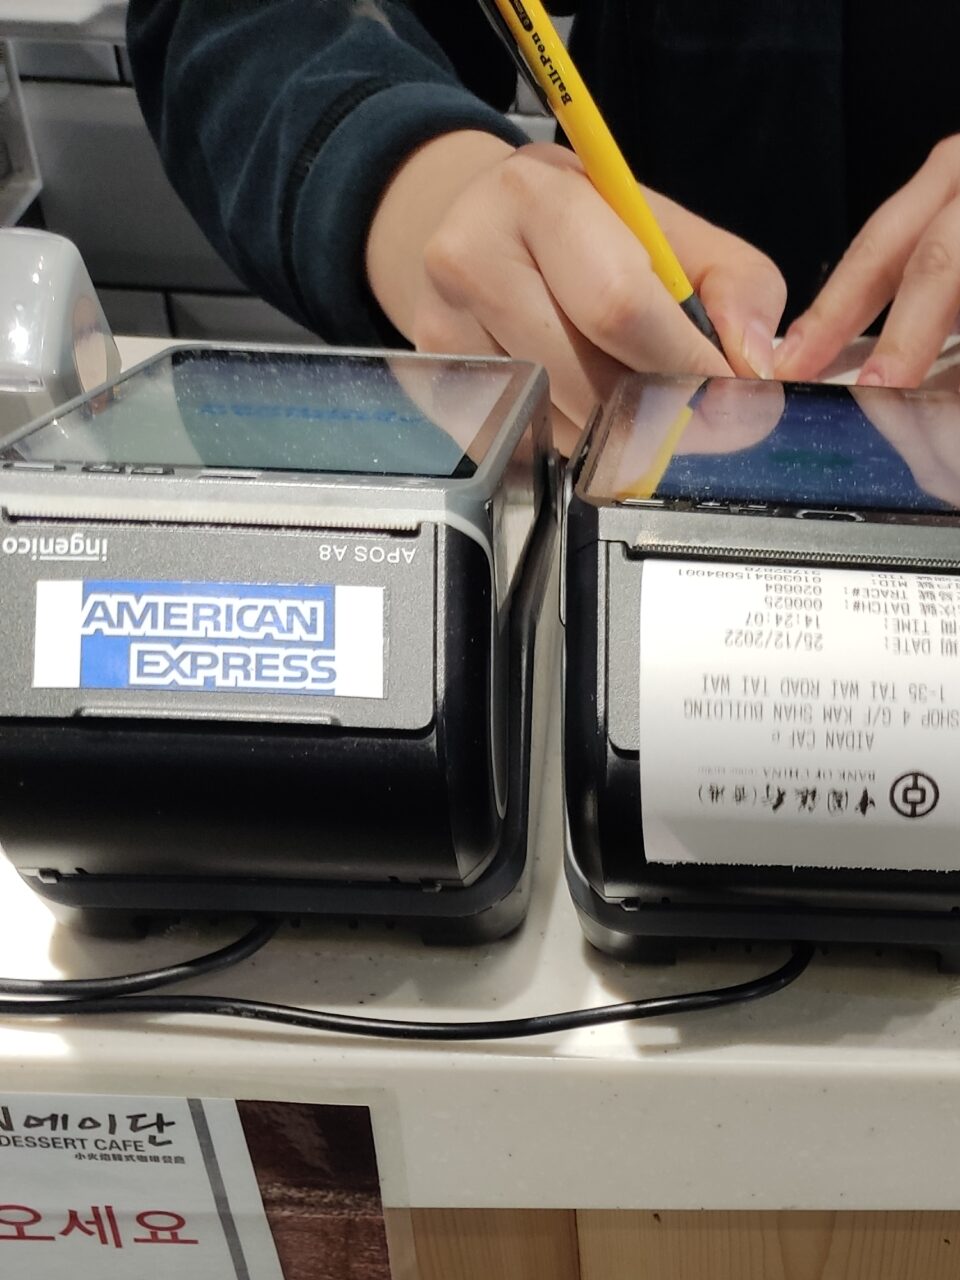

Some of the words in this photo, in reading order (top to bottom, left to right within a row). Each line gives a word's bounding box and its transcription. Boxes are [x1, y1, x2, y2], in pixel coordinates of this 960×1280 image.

[532, 32, 572, 106] Ball-Pen
[2, 533, 108, 562] ingenico
[319, 544, 348, 562] A8
[354, 545, 417, 564] APOS
[82, 595, 323, 641] AMERICAN
[745, 612, 820, 630] 14:24:07
[884, 617, 930, 635] TIME:
[725, 629, 823, 652] 25/12/2022
[884, 636, 931, 656] DATE:
[132, 645, 337, 688] EXPRESS
[701, 674, 730, 696] WAI
[742, 676, 768, 697] TAI
[780, 678, 820, 698] ROAD
[831, 679, 860, 700] WAI
[870, 680, 897, 701] TAI
[908, 682, 946, 702] 1-35
[682, 699, 764, 724] BUILDING
[773, 703, 814, 725] SHAN
[822, 705, 854, 726] KAM
[866, 706, 892, 727] G/F
[902, 708, 911, 727] 4
[921, 708, 960, 728] SHOP
[825, 729, 875, 752] AIDAN
[840, 769, 876, 782] BANK
[0, 1134, 87, 1150] DESSERT
[94, 1138, 146, 1152] CAFE
[0, 1204, 199, 1249] 오세요
